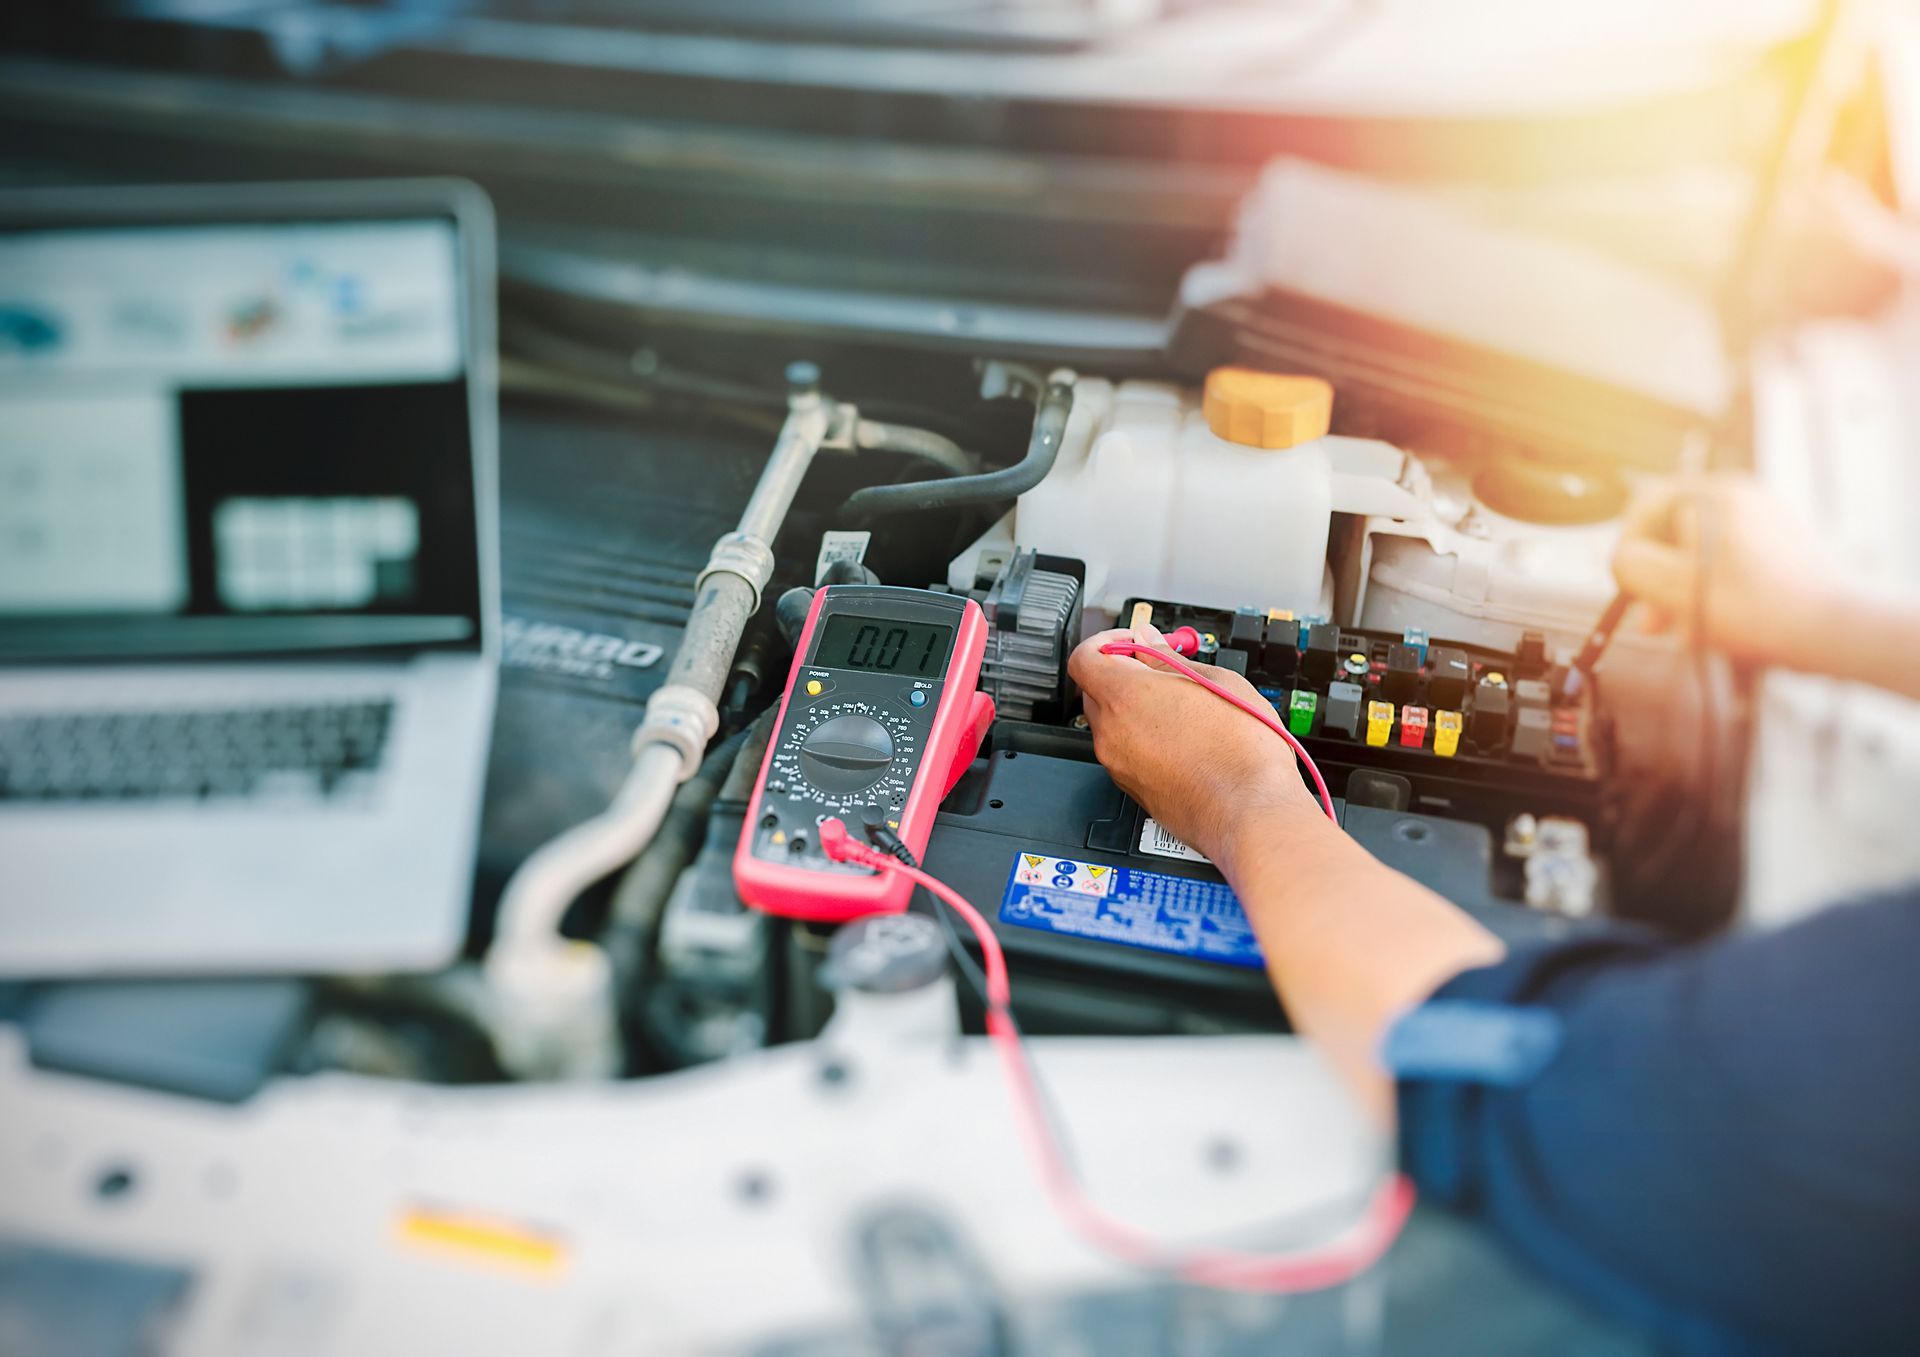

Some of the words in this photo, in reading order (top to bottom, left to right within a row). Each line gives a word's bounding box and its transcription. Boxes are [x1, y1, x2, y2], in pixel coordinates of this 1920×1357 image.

[847, 625, 937, 671] 0.01
[809, 670, 830, 678] POWER
[913, 681, 933, 689] HOLD
